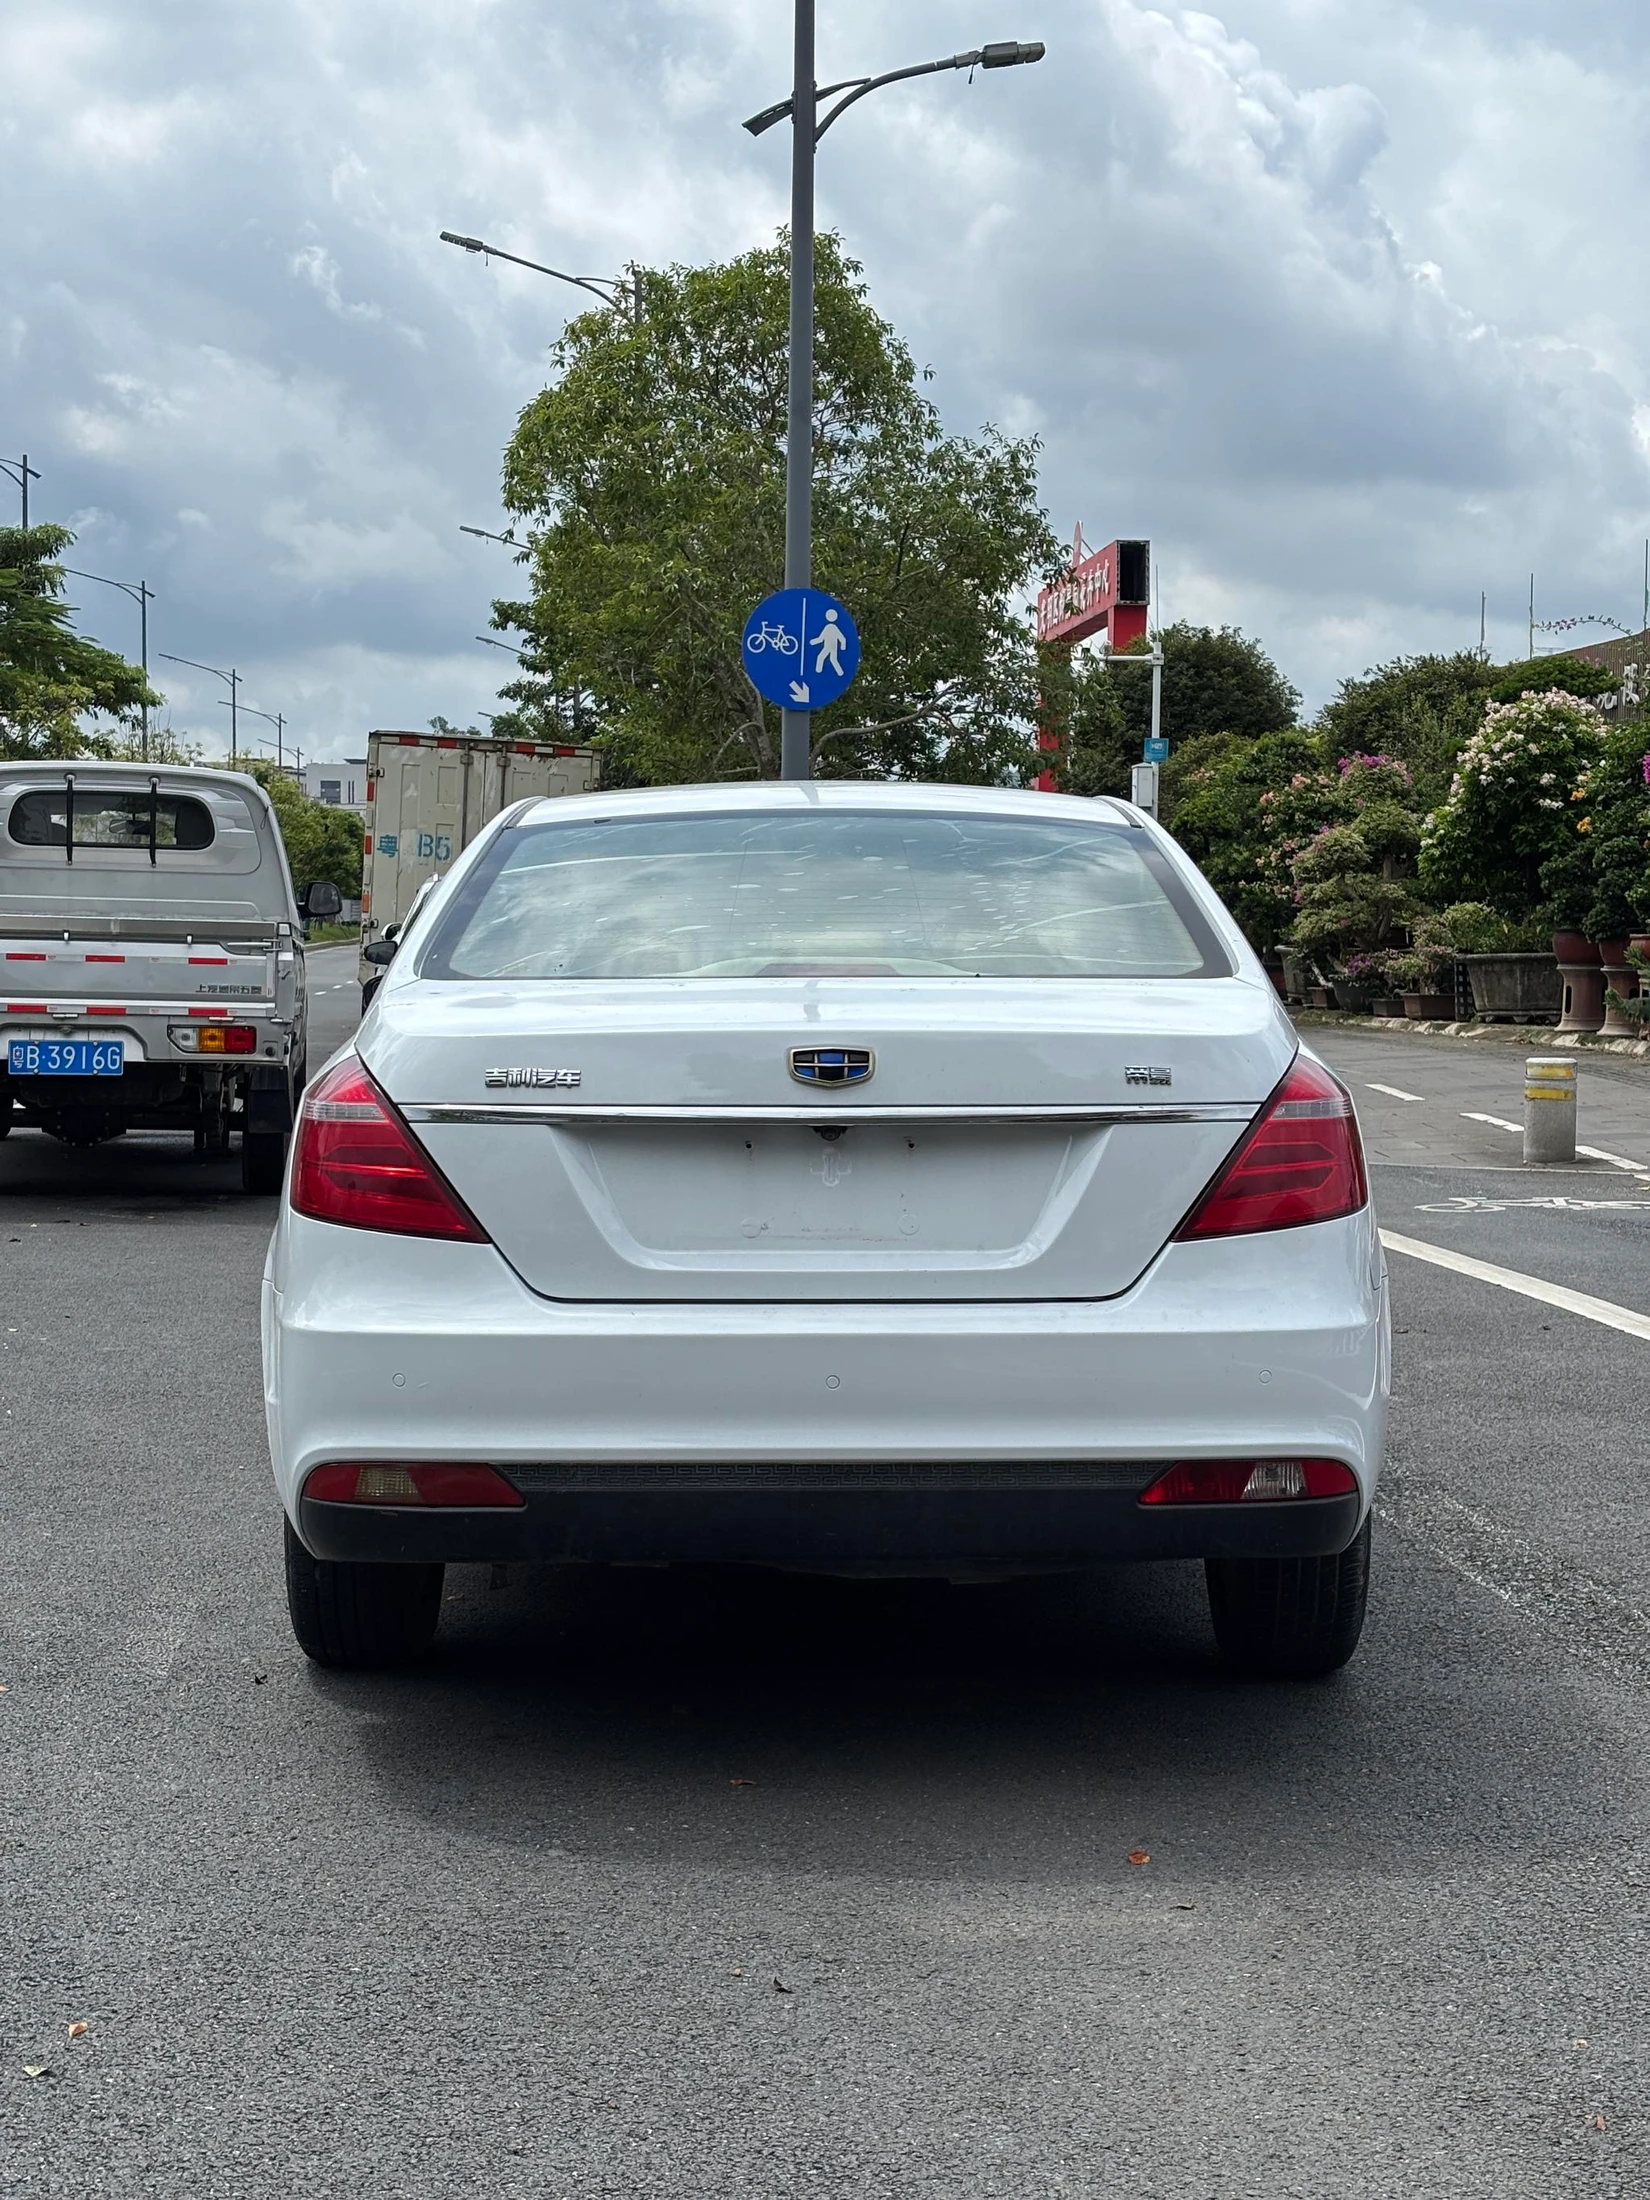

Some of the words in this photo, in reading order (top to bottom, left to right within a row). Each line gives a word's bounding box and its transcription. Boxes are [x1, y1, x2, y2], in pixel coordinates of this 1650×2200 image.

[376, 834, 399, 858] 粤
[417, 833, 451, 861] B5
[485, 1067, 581, 1089] 吉利汽车
